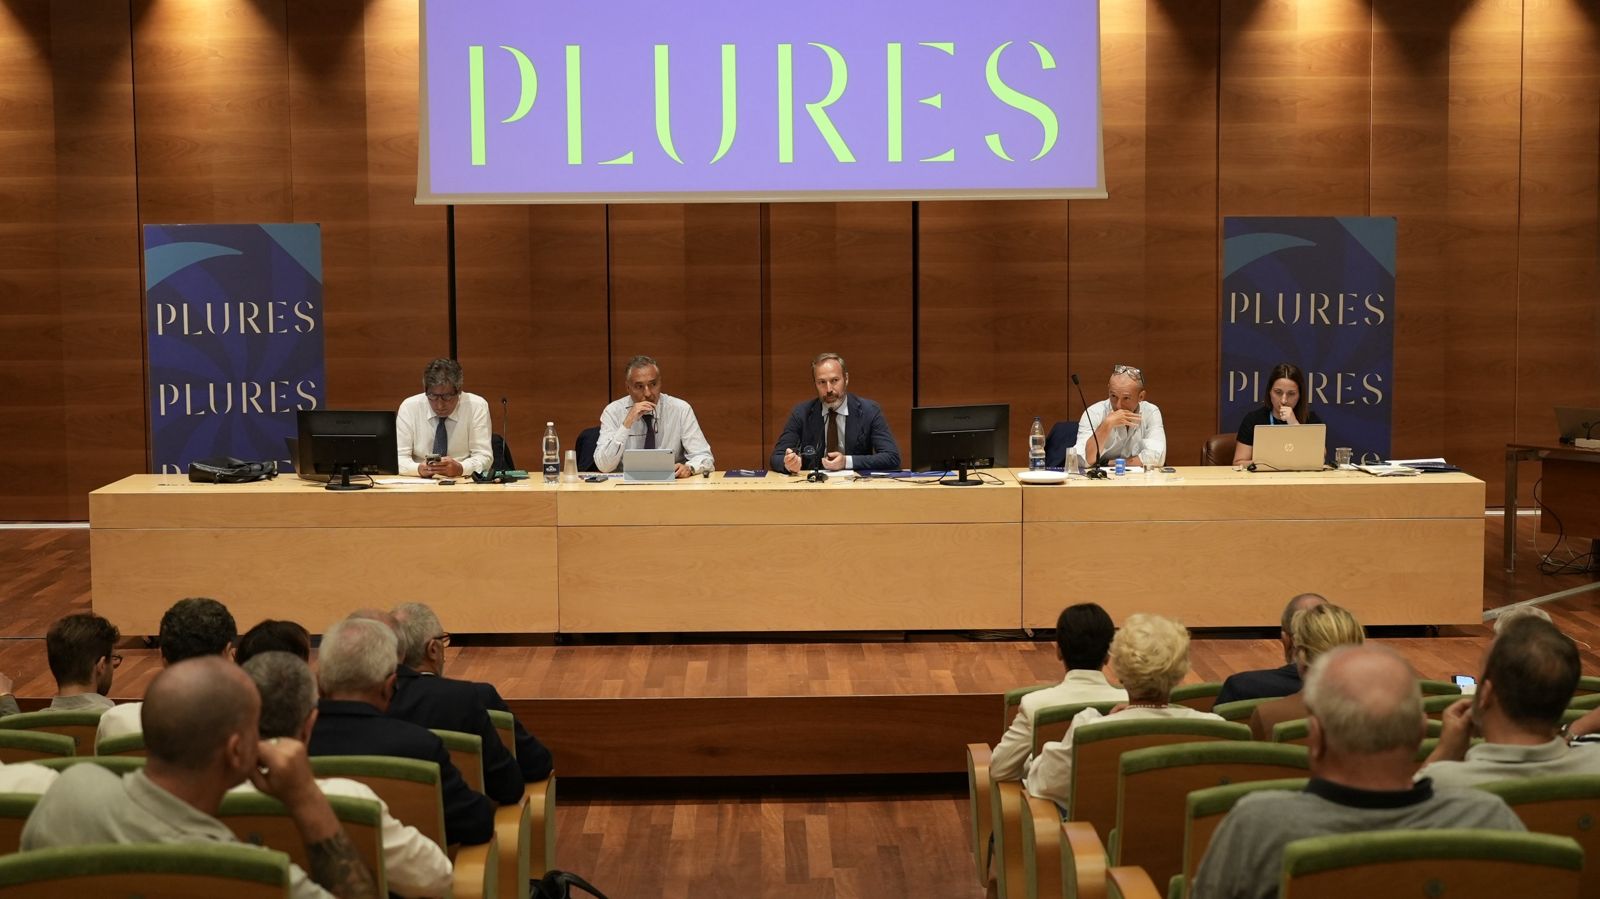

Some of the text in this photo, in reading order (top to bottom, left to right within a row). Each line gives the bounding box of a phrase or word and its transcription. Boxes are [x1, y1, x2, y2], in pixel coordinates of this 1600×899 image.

[468, 41, 1059, 166] PLURES
[156, 301, 316, 336] PLURES
[1229, 291, 1386, 326] PLURES
[159, 380, 318, 416] PLURES
[1228, 370, 1384, 406] PLRES
